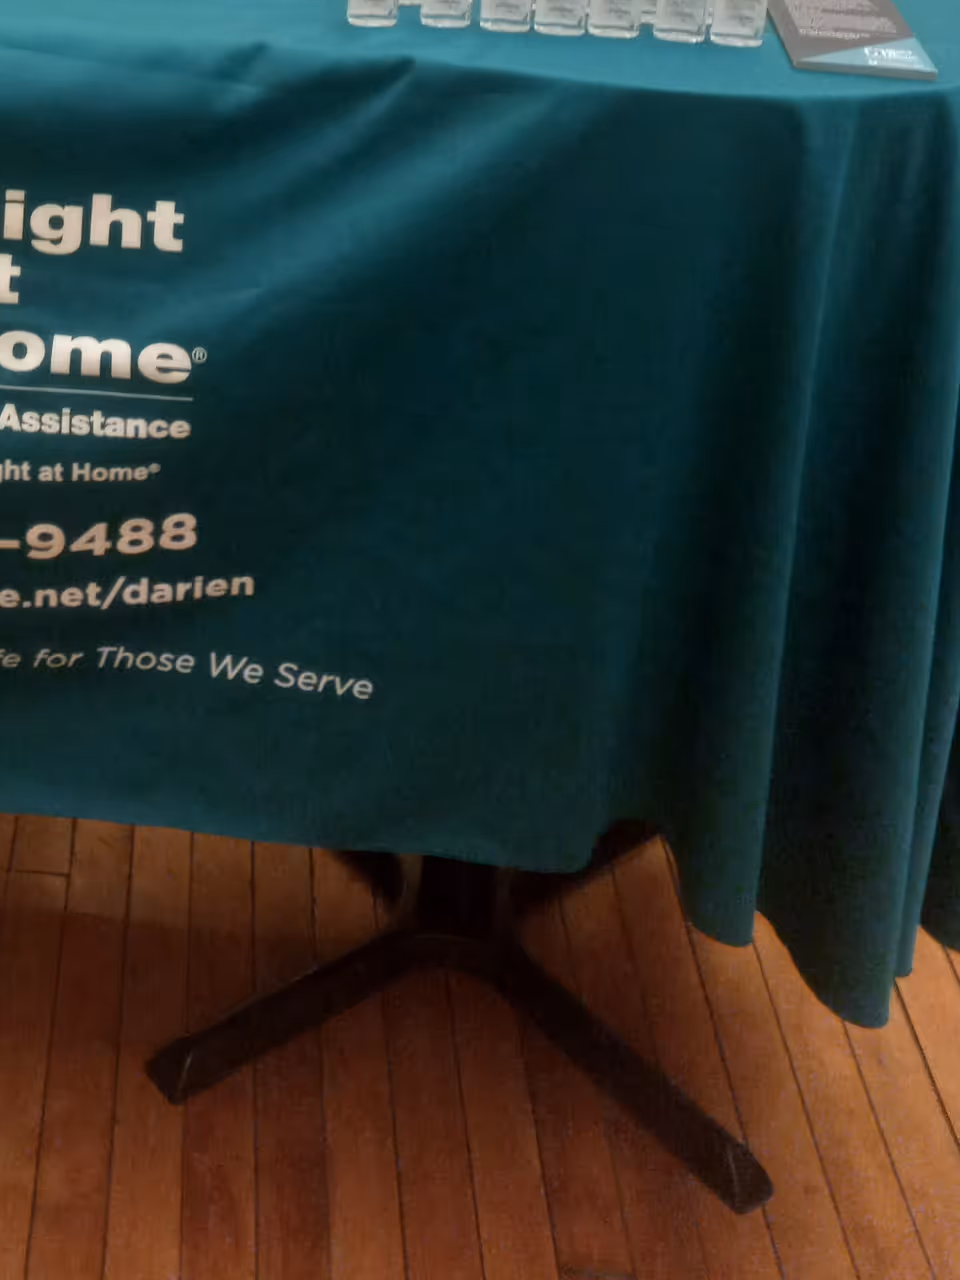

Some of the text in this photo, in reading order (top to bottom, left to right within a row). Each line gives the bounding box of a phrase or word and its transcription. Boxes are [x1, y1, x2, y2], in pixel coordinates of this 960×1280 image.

[38, 462, 64, 482] at
[32, 648, 85, 669] for
[96, 646, 196, 674] Those
[209, 652, 265, 685] We
[274, 662, 374, 701] Serve
